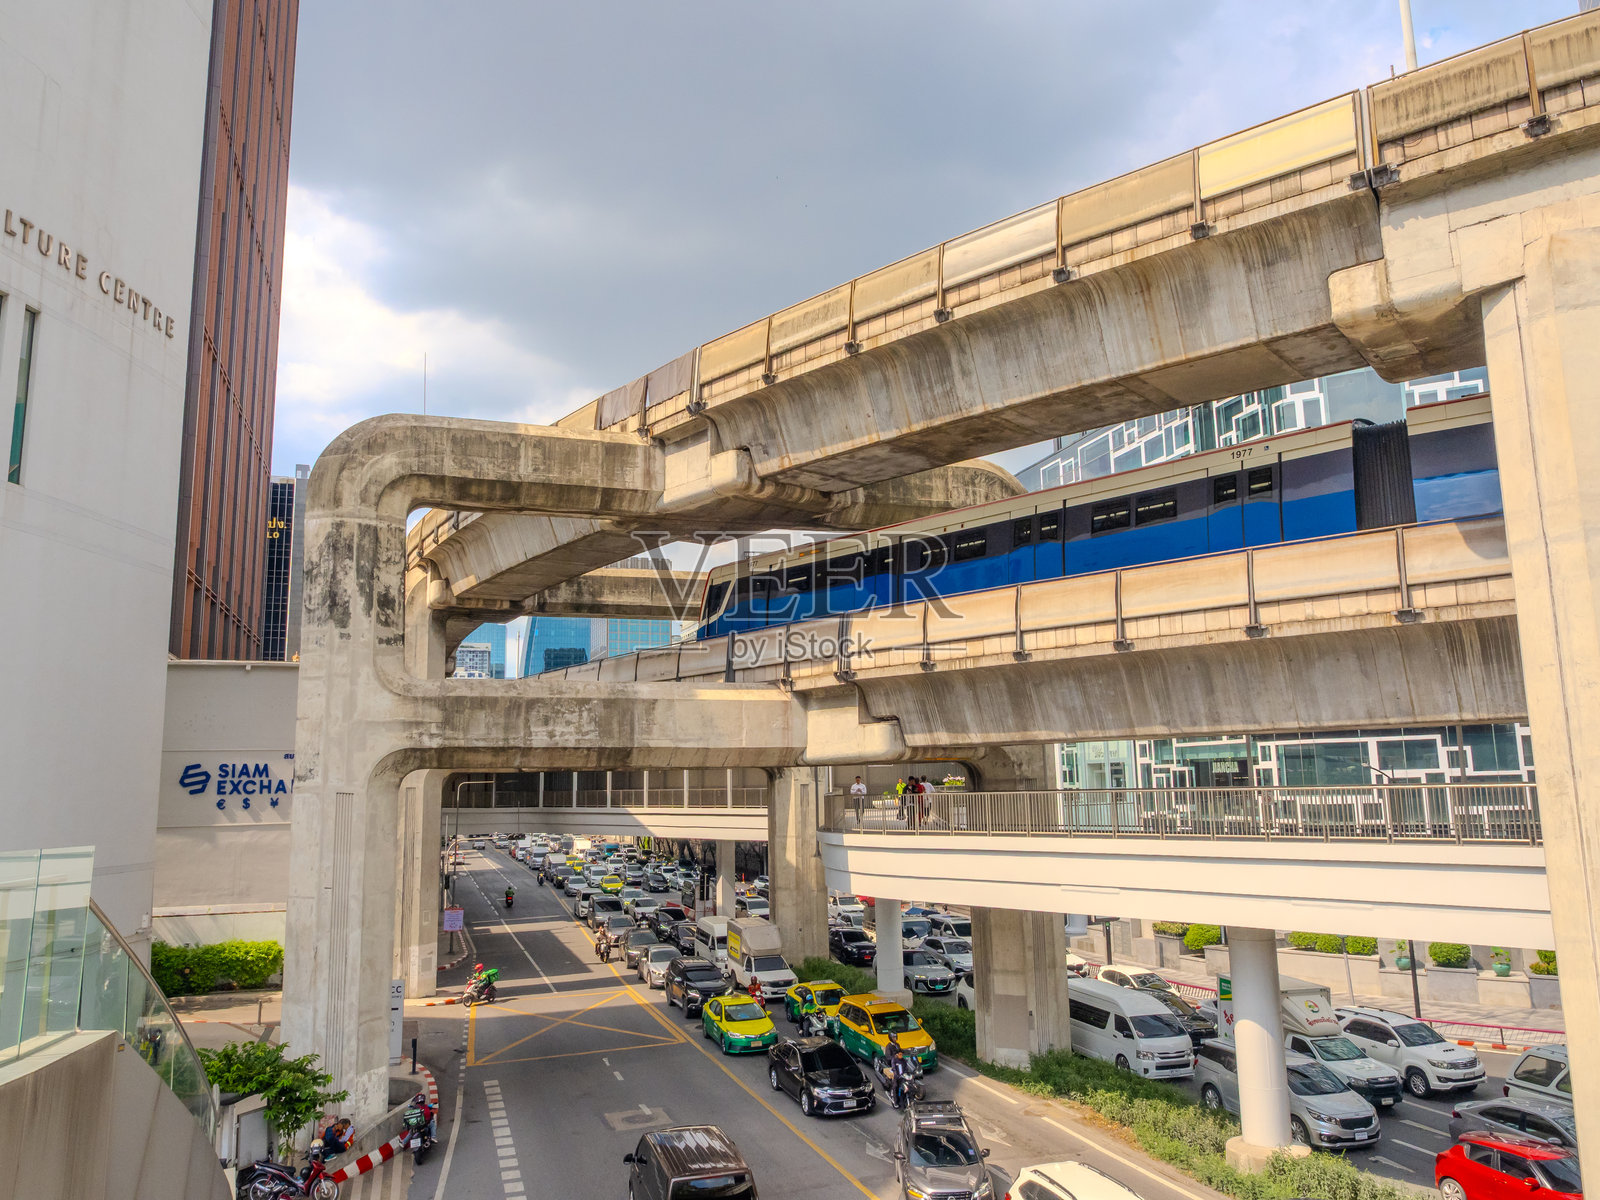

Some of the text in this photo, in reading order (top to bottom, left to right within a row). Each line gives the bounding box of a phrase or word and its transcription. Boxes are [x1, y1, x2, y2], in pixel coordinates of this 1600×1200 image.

[4, 209, 175, 338] LTURE CENTRE
[1231, 448, 1252, 459] 1977
[218, 763, 270, 778] SIAM
[216, 779, 295, 795] EXCHA
